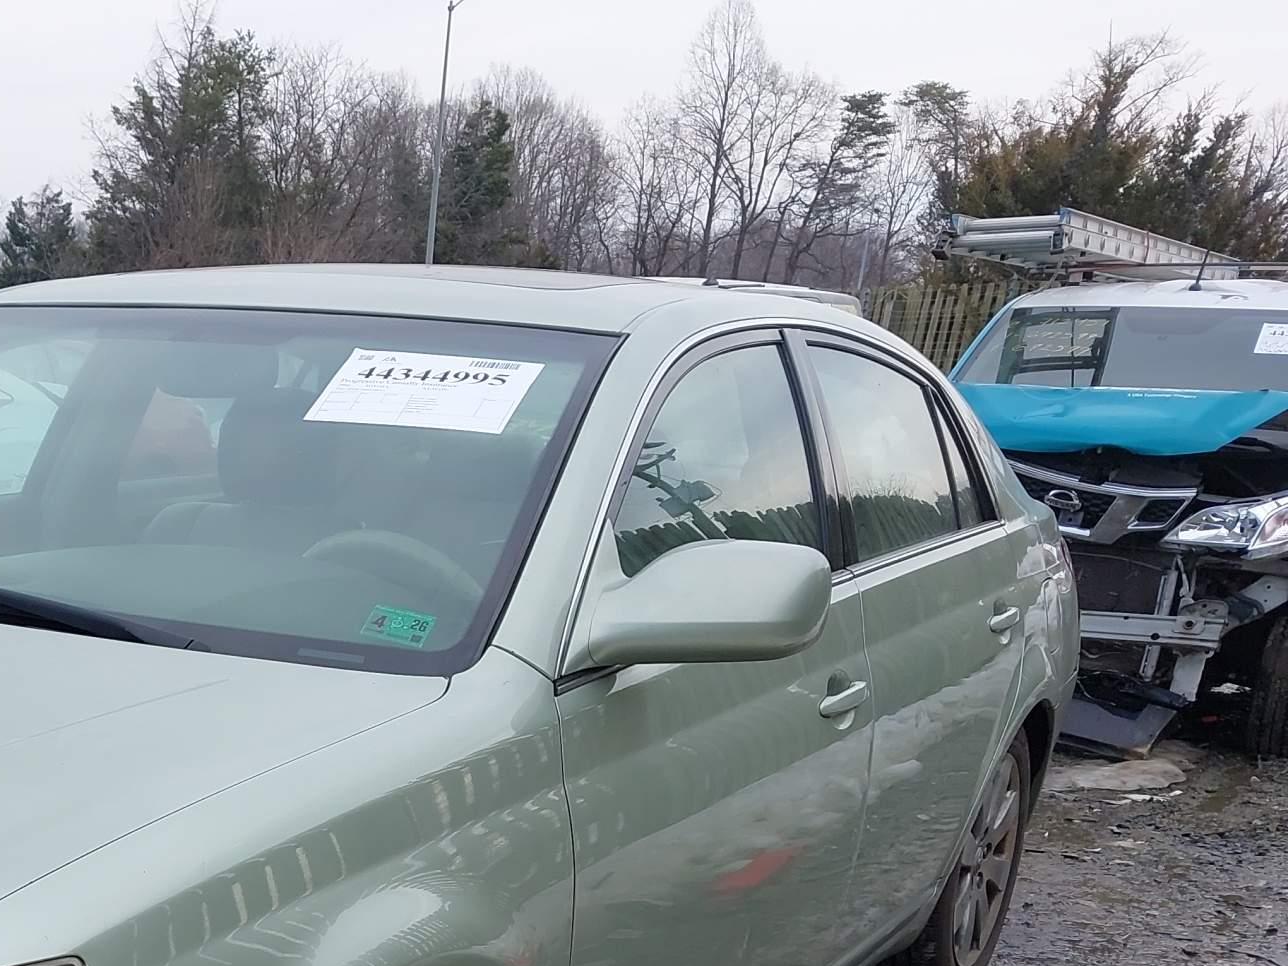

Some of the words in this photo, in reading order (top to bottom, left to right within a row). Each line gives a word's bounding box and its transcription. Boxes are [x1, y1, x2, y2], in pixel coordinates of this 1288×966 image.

[357, 366, 510, 386] 44344995
[371, 615, 387, 629] 4
[410, 619, 430, 633] 26
